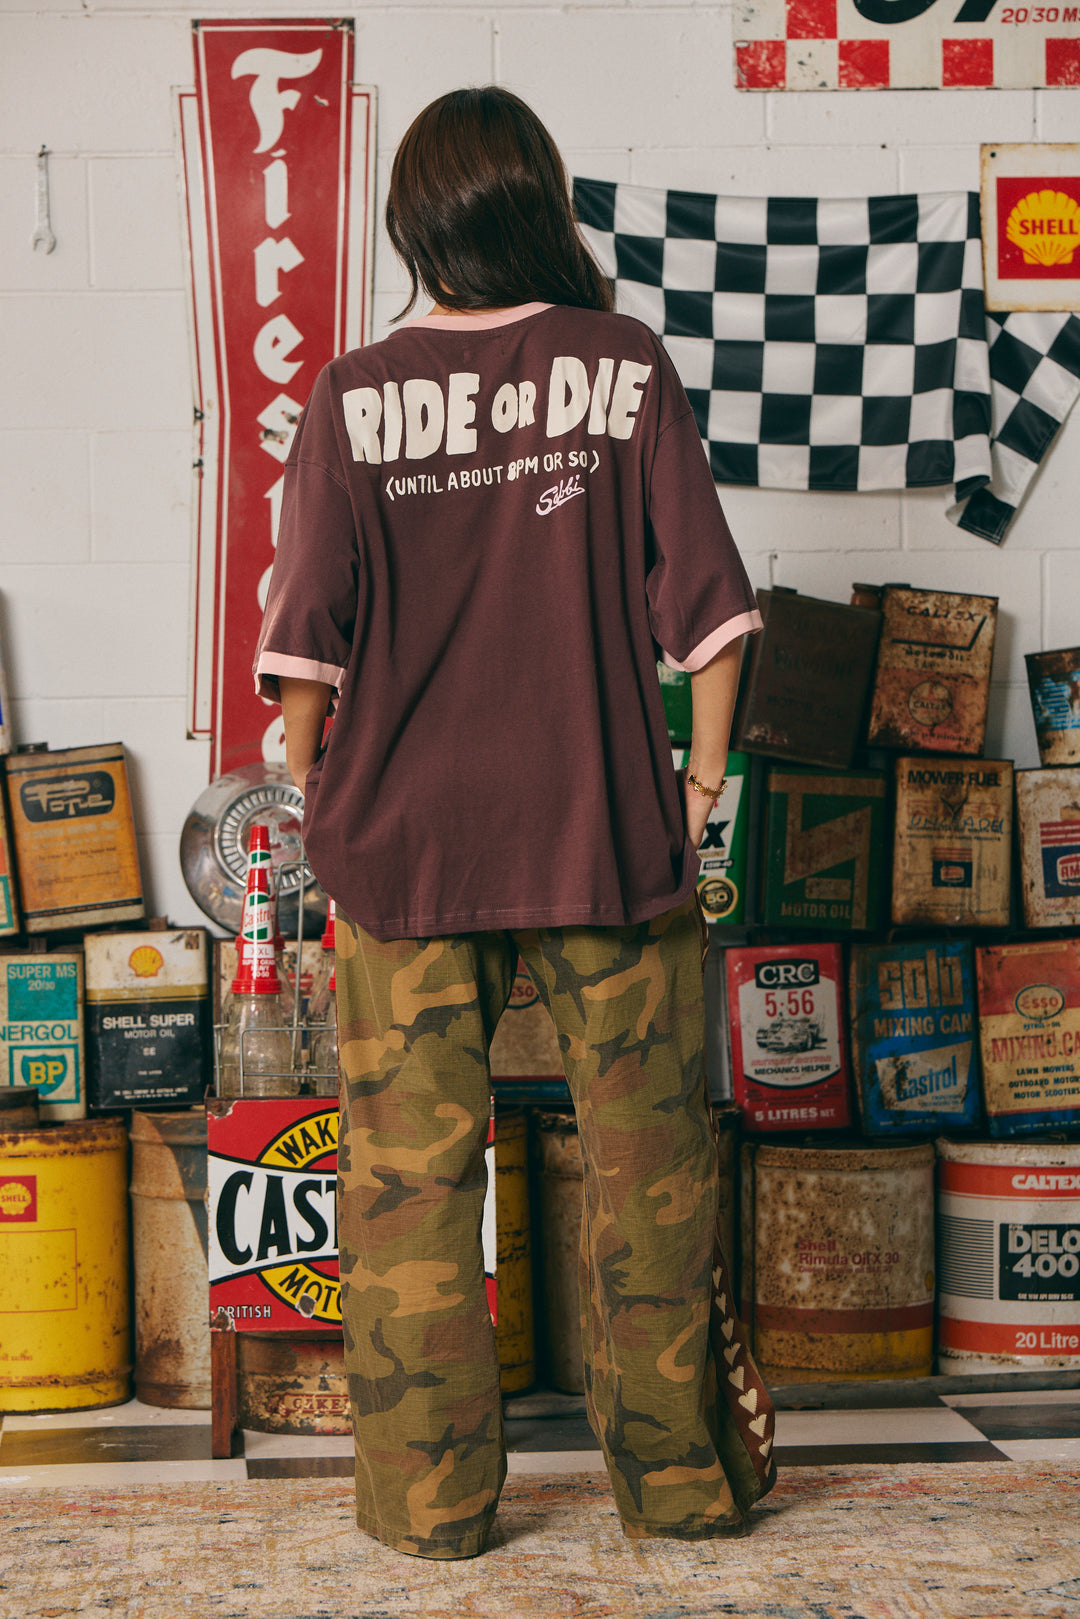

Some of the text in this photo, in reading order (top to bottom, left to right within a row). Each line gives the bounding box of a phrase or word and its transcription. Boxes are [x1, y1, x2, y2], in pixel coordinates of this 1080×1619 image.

[1062, 7, 1080, 23] M
[1018, 218, 1079, 236] SHELL
[342, 355, 653, 465] RIDE OR DIE
[447, 465, 504, 492] ABOUT
[506, 455, 538, 481] 8PM
[543, 451, 563, 473] OR
[908, 769, 1002, 786] MOWER FUEL
[781, 901, 851, 919] MOTOR OIL
[8, 965, 76, 980] SUPER MS
[759, 963, 816, 985] CRC
[102, 1013, 195, 1030] SHELL SUPER
[874, 1013, 973, 1039] MIXING CAN
[124, 1028, 175, 1040] MOTOR OIL
[991, 1032, 1057, 1064] MIXING
[28, 1061, 64, 1085] BP
[894, 1055, 958, 1102] Castrol
[1016, 1064, 1075, 1076] LAWN MOWERS
[1008, 1076, 1080, 1089] OUTBOARD MOTOR
[1014, 1090, 1041, 1100] MOTOR
[754, 1110, 764, 1122] 5
[767, 1107, 818, 1121] LITRES
[275, 1116, 338, 1166] WAK
[1012, 1174, 1080, 1190] CALTEX
[1, 1194, 26, 1203] SHELL
[799, 1240, 837, 1252] Shell
[1008, 1229, 1080, 1254] DELO
[799, 1252, 848, 1265] Rimula
[851, 1252, 870, 1266] Oil
[884, 1252, 900, 1264] 30
[1012, 1253, 1080, 1278] 400
[1015, 1332, 1037, 1348] 20
